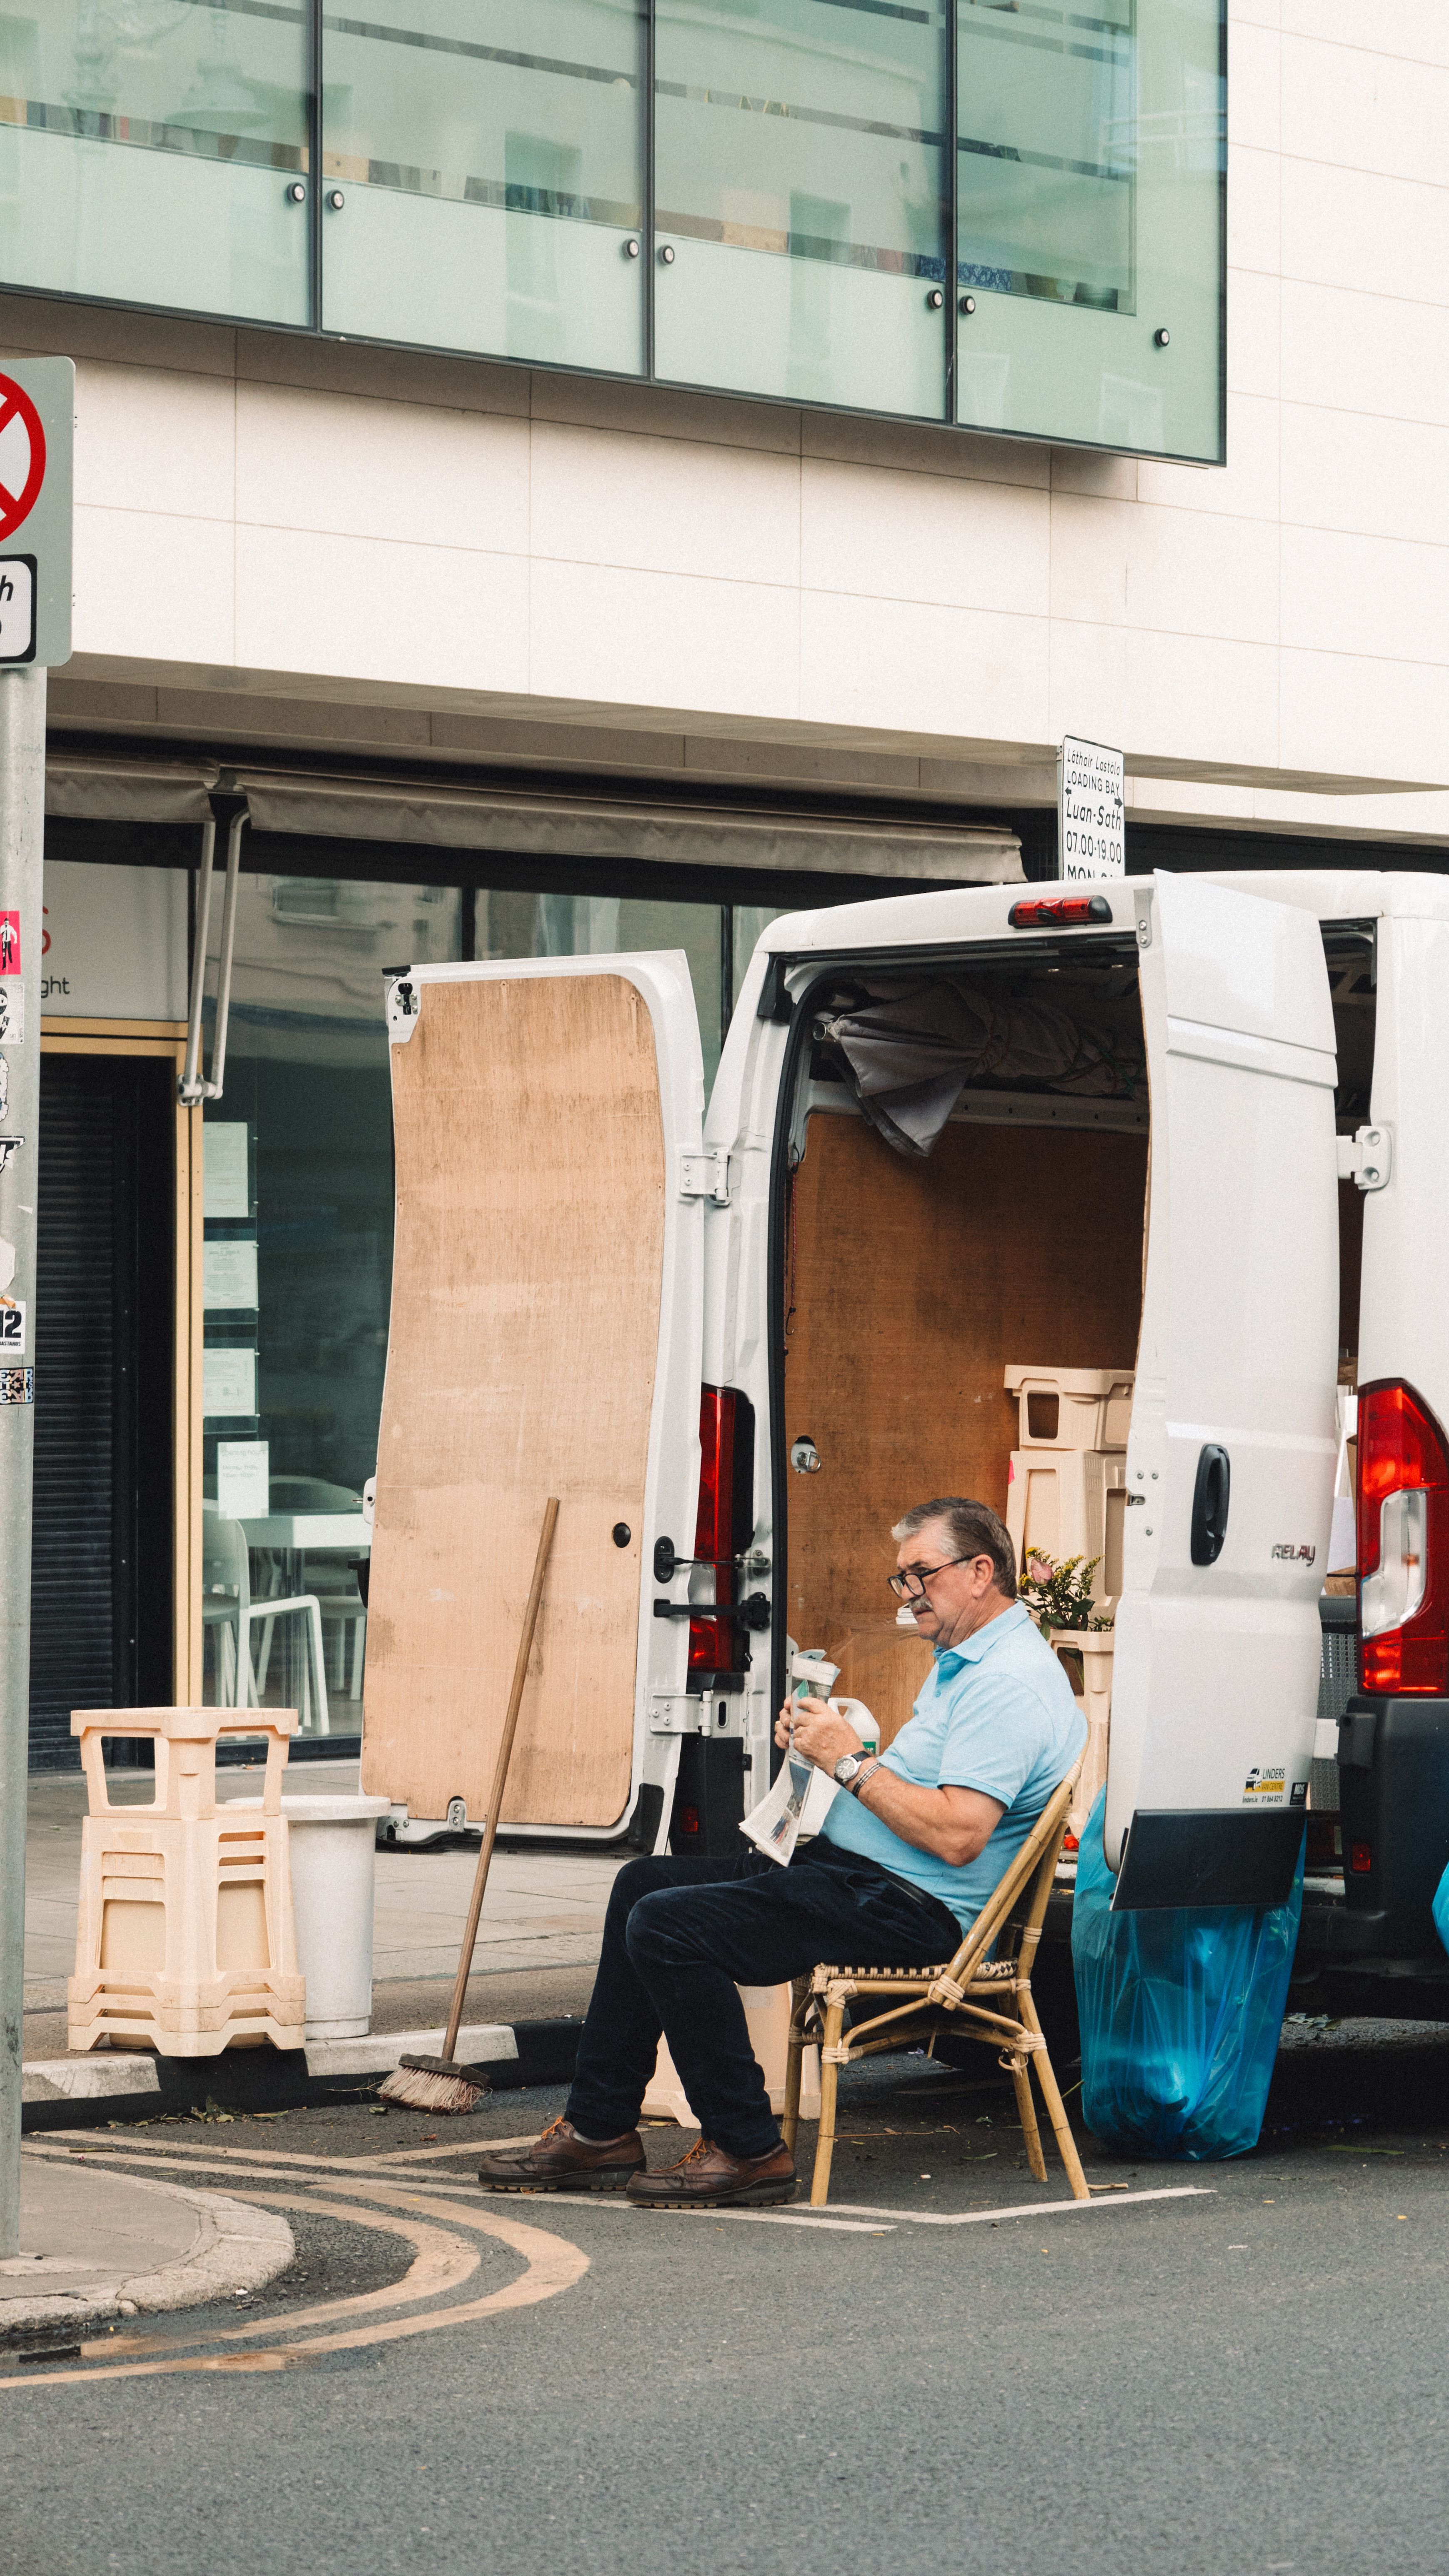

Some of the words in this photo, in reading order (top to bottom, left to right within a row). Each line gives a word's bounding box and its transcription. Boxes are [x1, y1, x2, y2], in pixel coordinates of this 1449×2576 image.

[1067, 748, 1093, 768] Láthair
[1095, 756, 1120, 776] Lastála
[1067, 769, 1102, 792] LOADING
[1105, 780, 1120, 796] BAY
[1066, 797, 1121, 831] Luan-Sath
[1066, 830, 1122, 864] 07.00-19.00
[1272, 1545, 1315, 1567] RELAY
[1262, 1768, 1285, 1779] LINDERS
